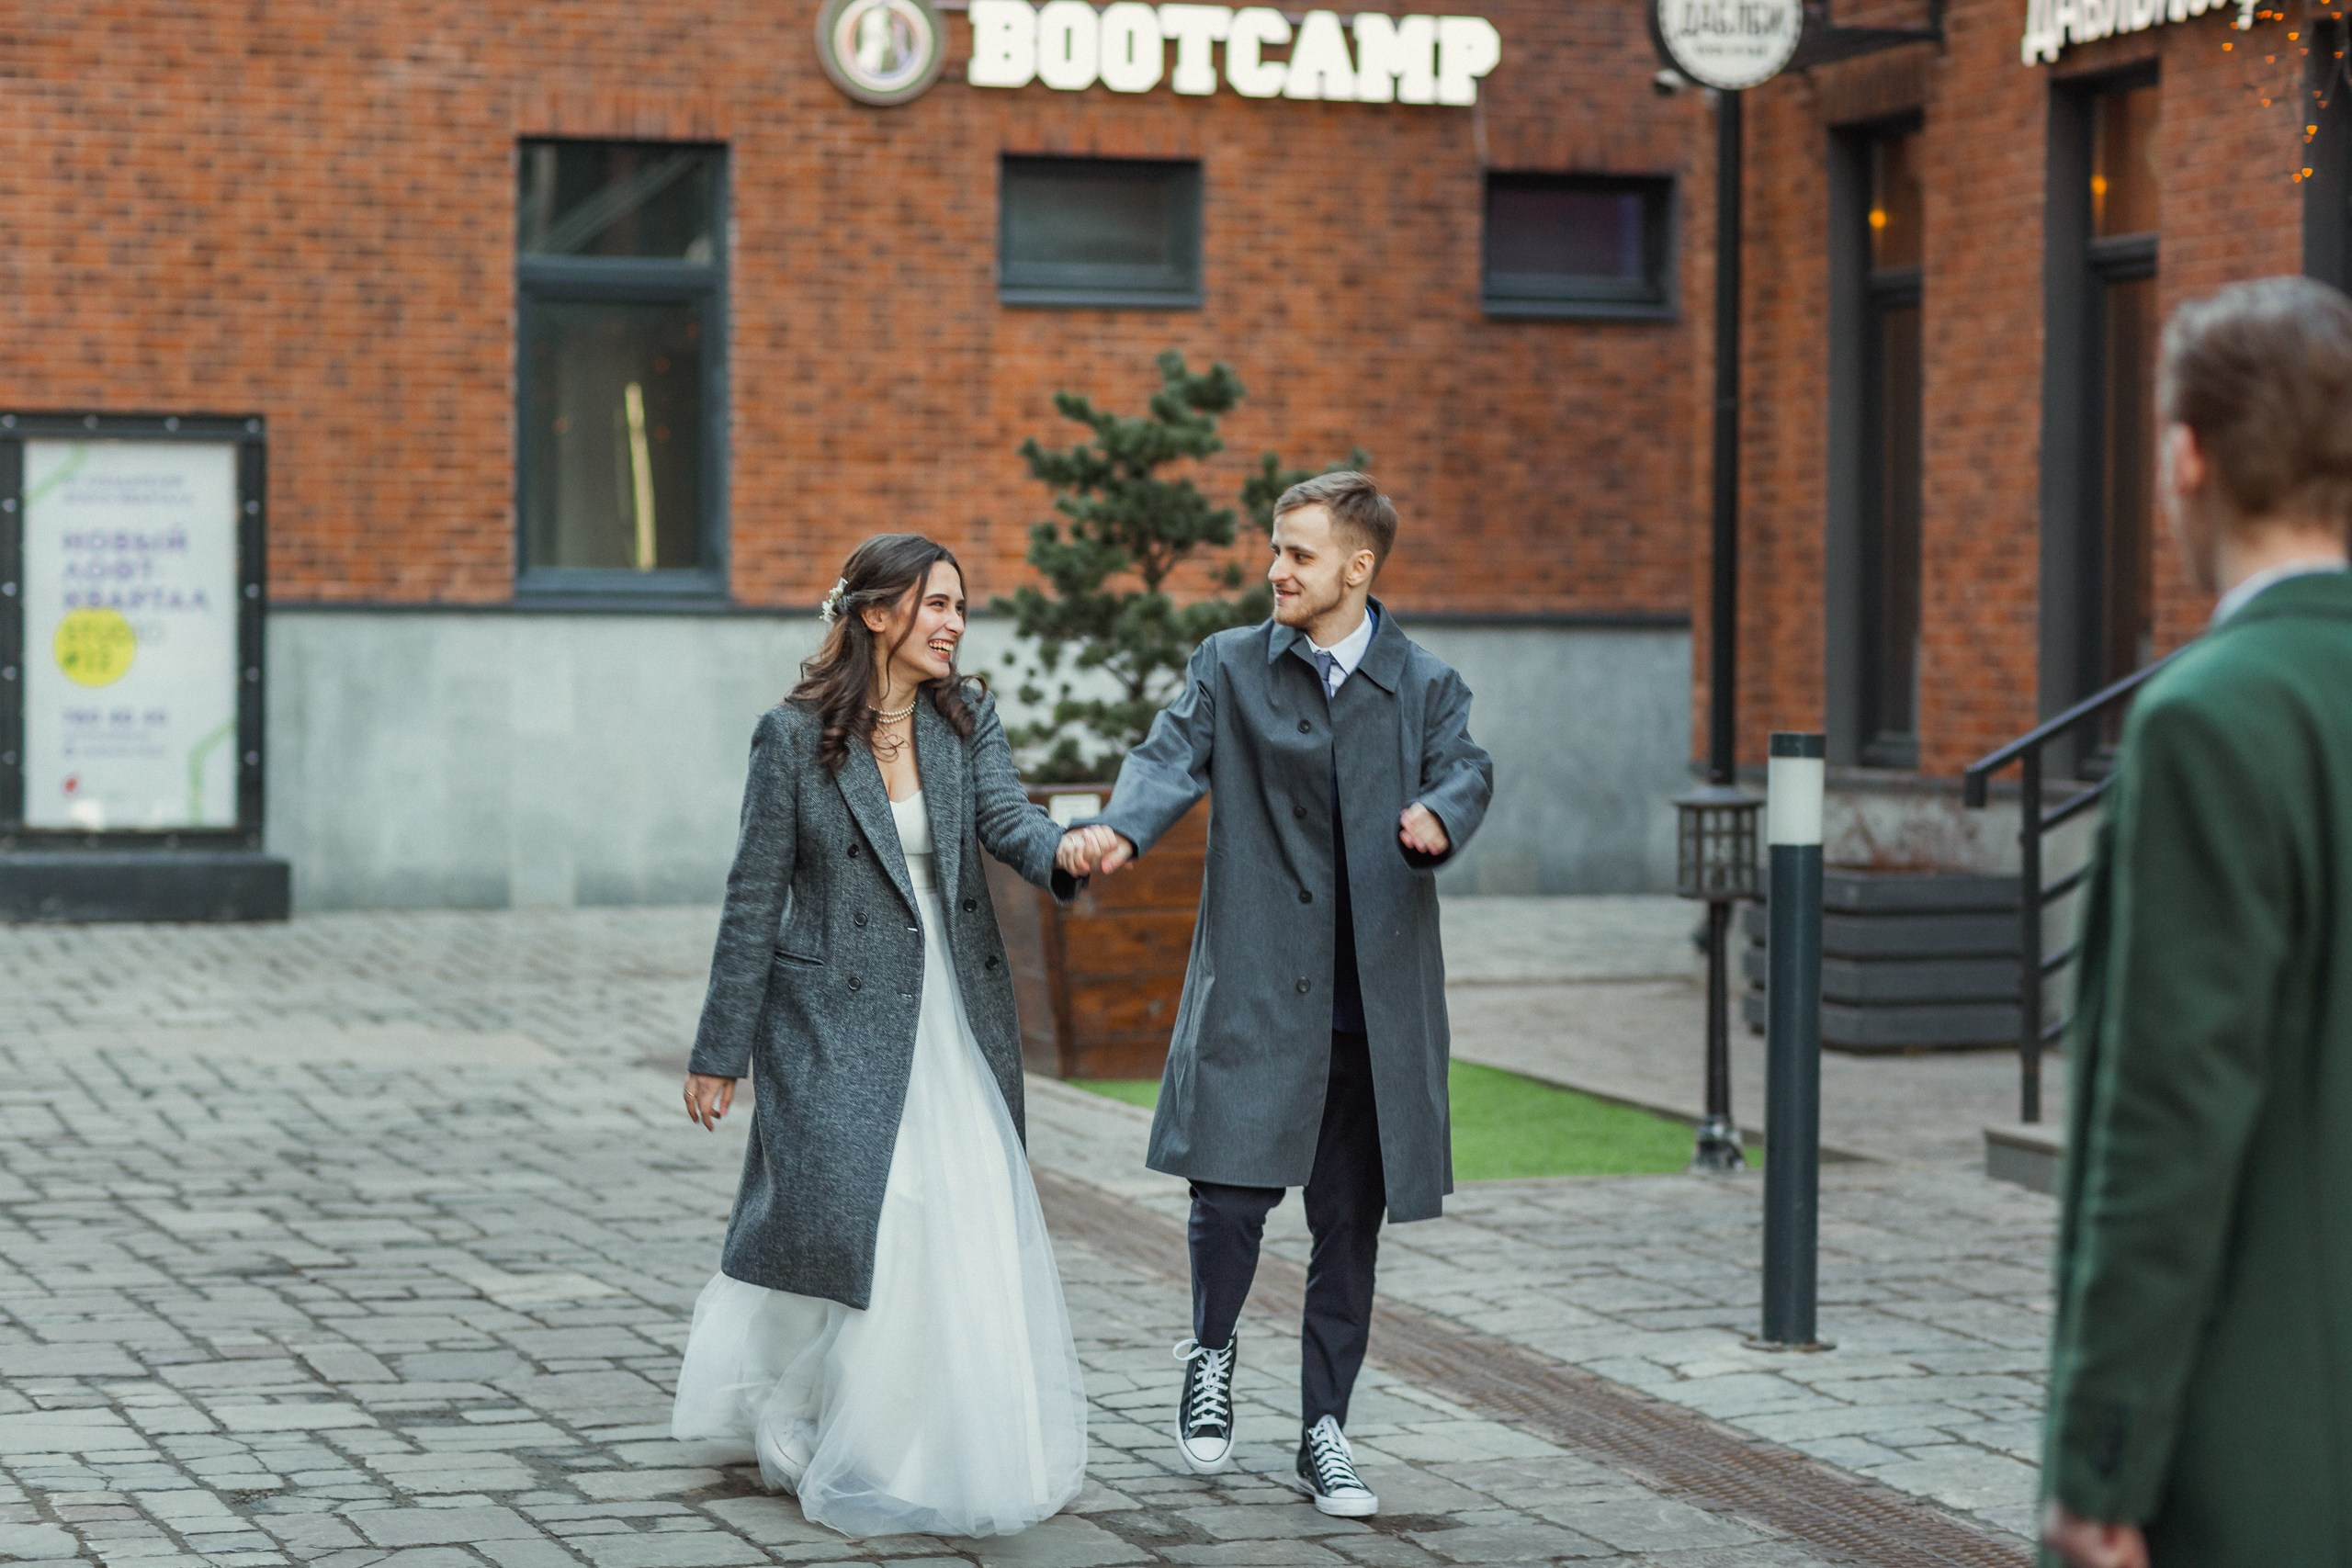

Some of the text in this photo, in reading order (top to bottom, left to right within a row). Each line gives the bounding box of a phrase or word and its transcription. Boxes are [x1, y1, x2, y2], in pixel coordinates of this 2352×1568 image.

[968, 0, 1502, 106] BOOTCAMP
[62, 525, 187, 552] НОВЫЙ
[62, 589, 209, 610] КВАРТАЛ
